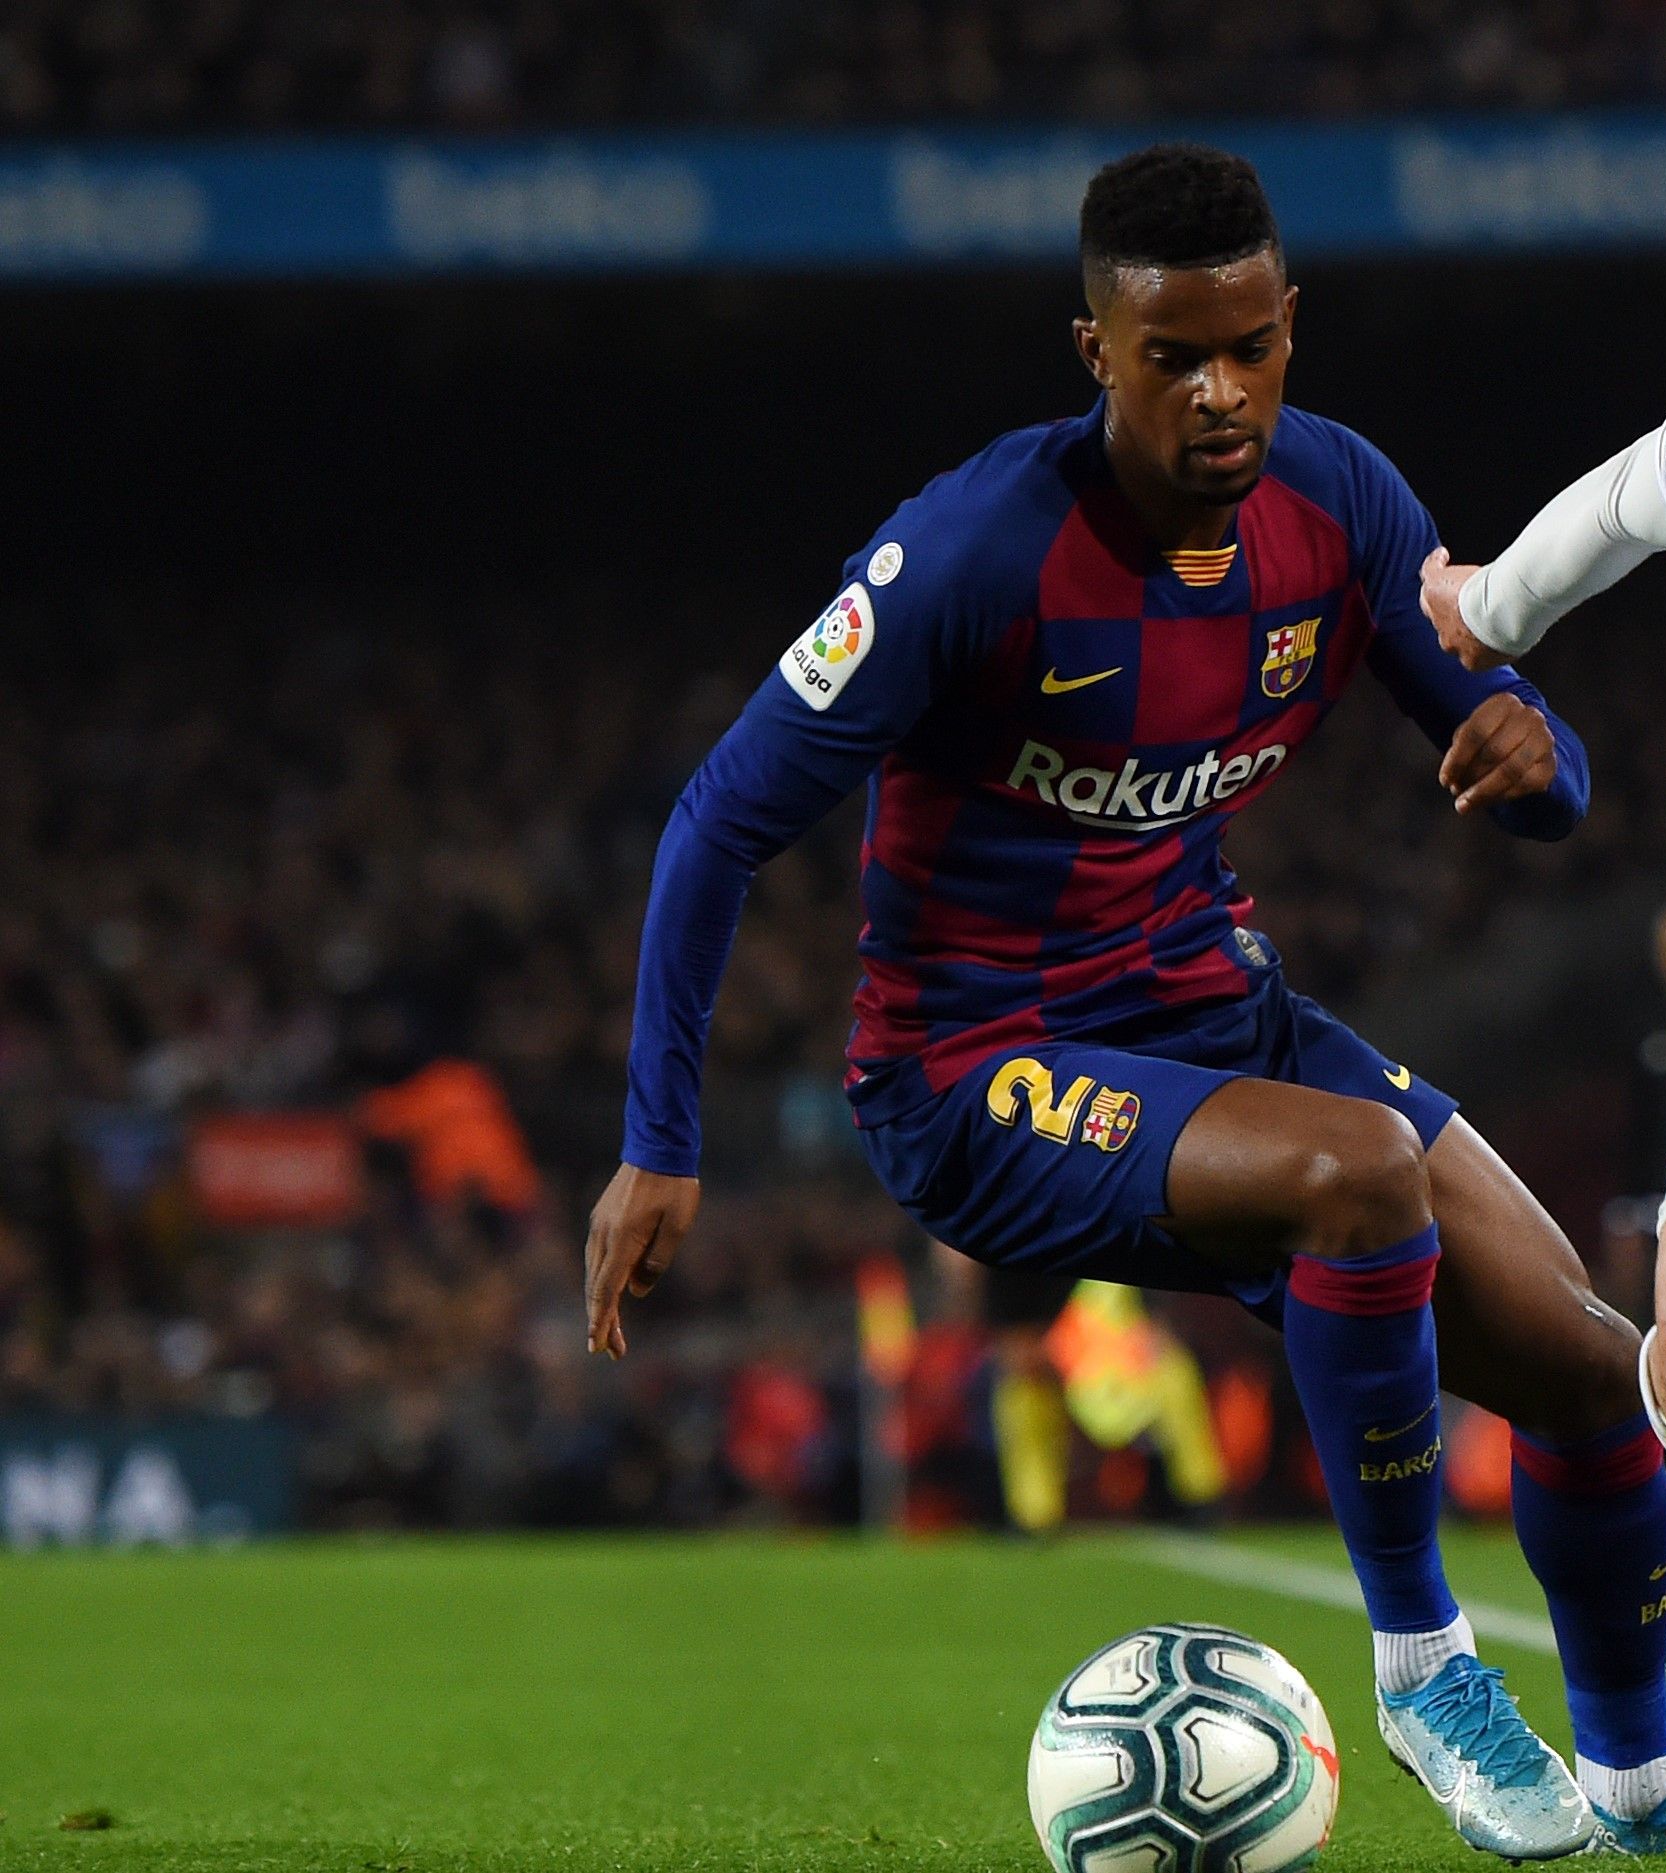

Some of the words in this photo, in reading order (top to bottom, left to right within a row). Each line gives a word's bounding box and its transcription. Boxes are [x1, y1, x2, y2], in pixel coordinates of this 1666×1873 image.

[0, 155, 206, 264] eko
[791, 641, 832, 693] LaLiga
[1007, 740, 1287, 817] Rakuten
[987, 1058, 1096, 1145] 2
